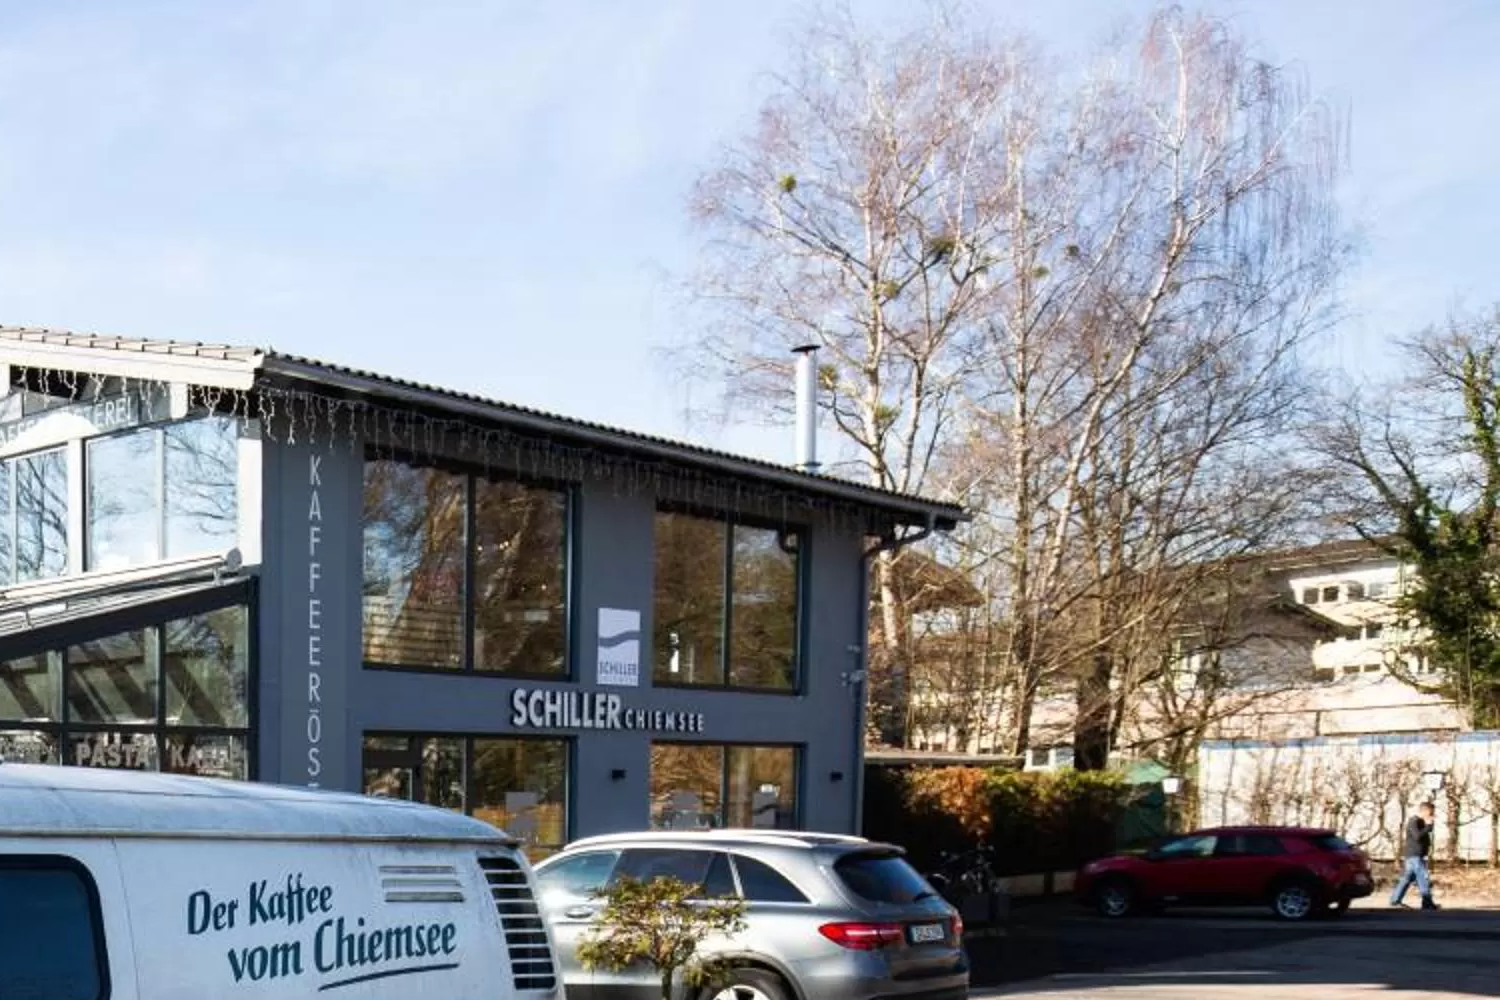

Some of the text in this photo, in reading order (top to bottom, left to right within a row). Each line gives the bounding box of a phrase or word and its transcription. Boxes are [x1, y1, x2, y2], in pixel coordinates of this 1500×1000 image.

[308, 455, 323, 788] KAFFEERÖS
[513, 688, 705, 732] SCHILLER CHIEMSEE
[187, 872, 334, 935] Der Kaffee
[227, 916, 457, 983] vom Chiemsee
